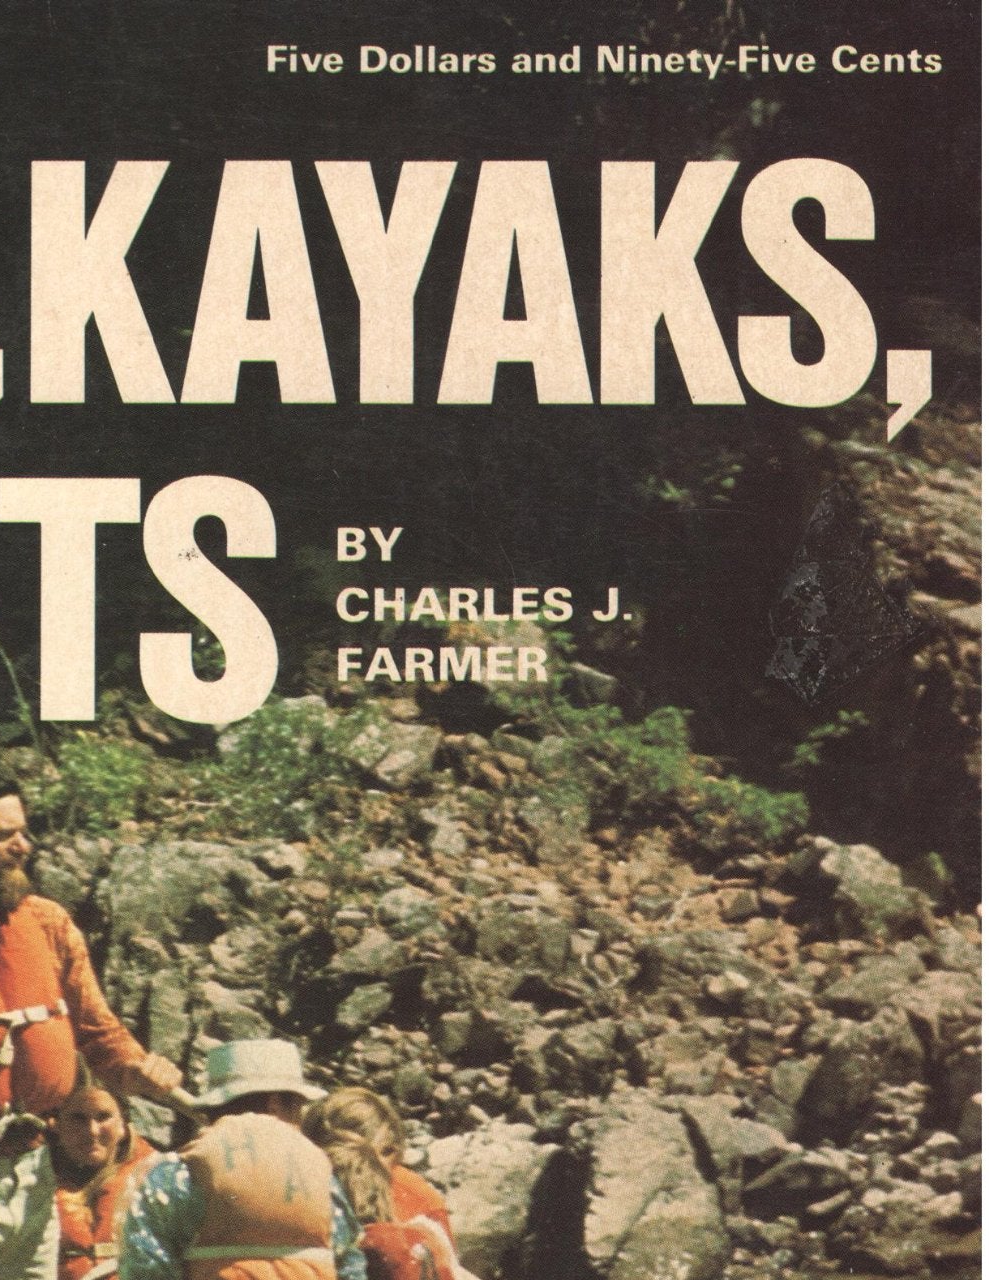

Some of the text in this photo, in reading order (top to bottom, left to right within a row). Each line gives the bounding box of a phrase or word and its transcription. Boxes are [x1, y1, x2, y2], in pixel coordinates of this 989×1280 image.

[267, 44, 942, 80] Five Dollars and Ninety-Five Cents
[30, 157, 933, 442] KAYAKS,
[336, 527, 403, 562] BY
[335, 587, 634, 623] CHARLES J.
[336, 647, 549, 683] FARMER
